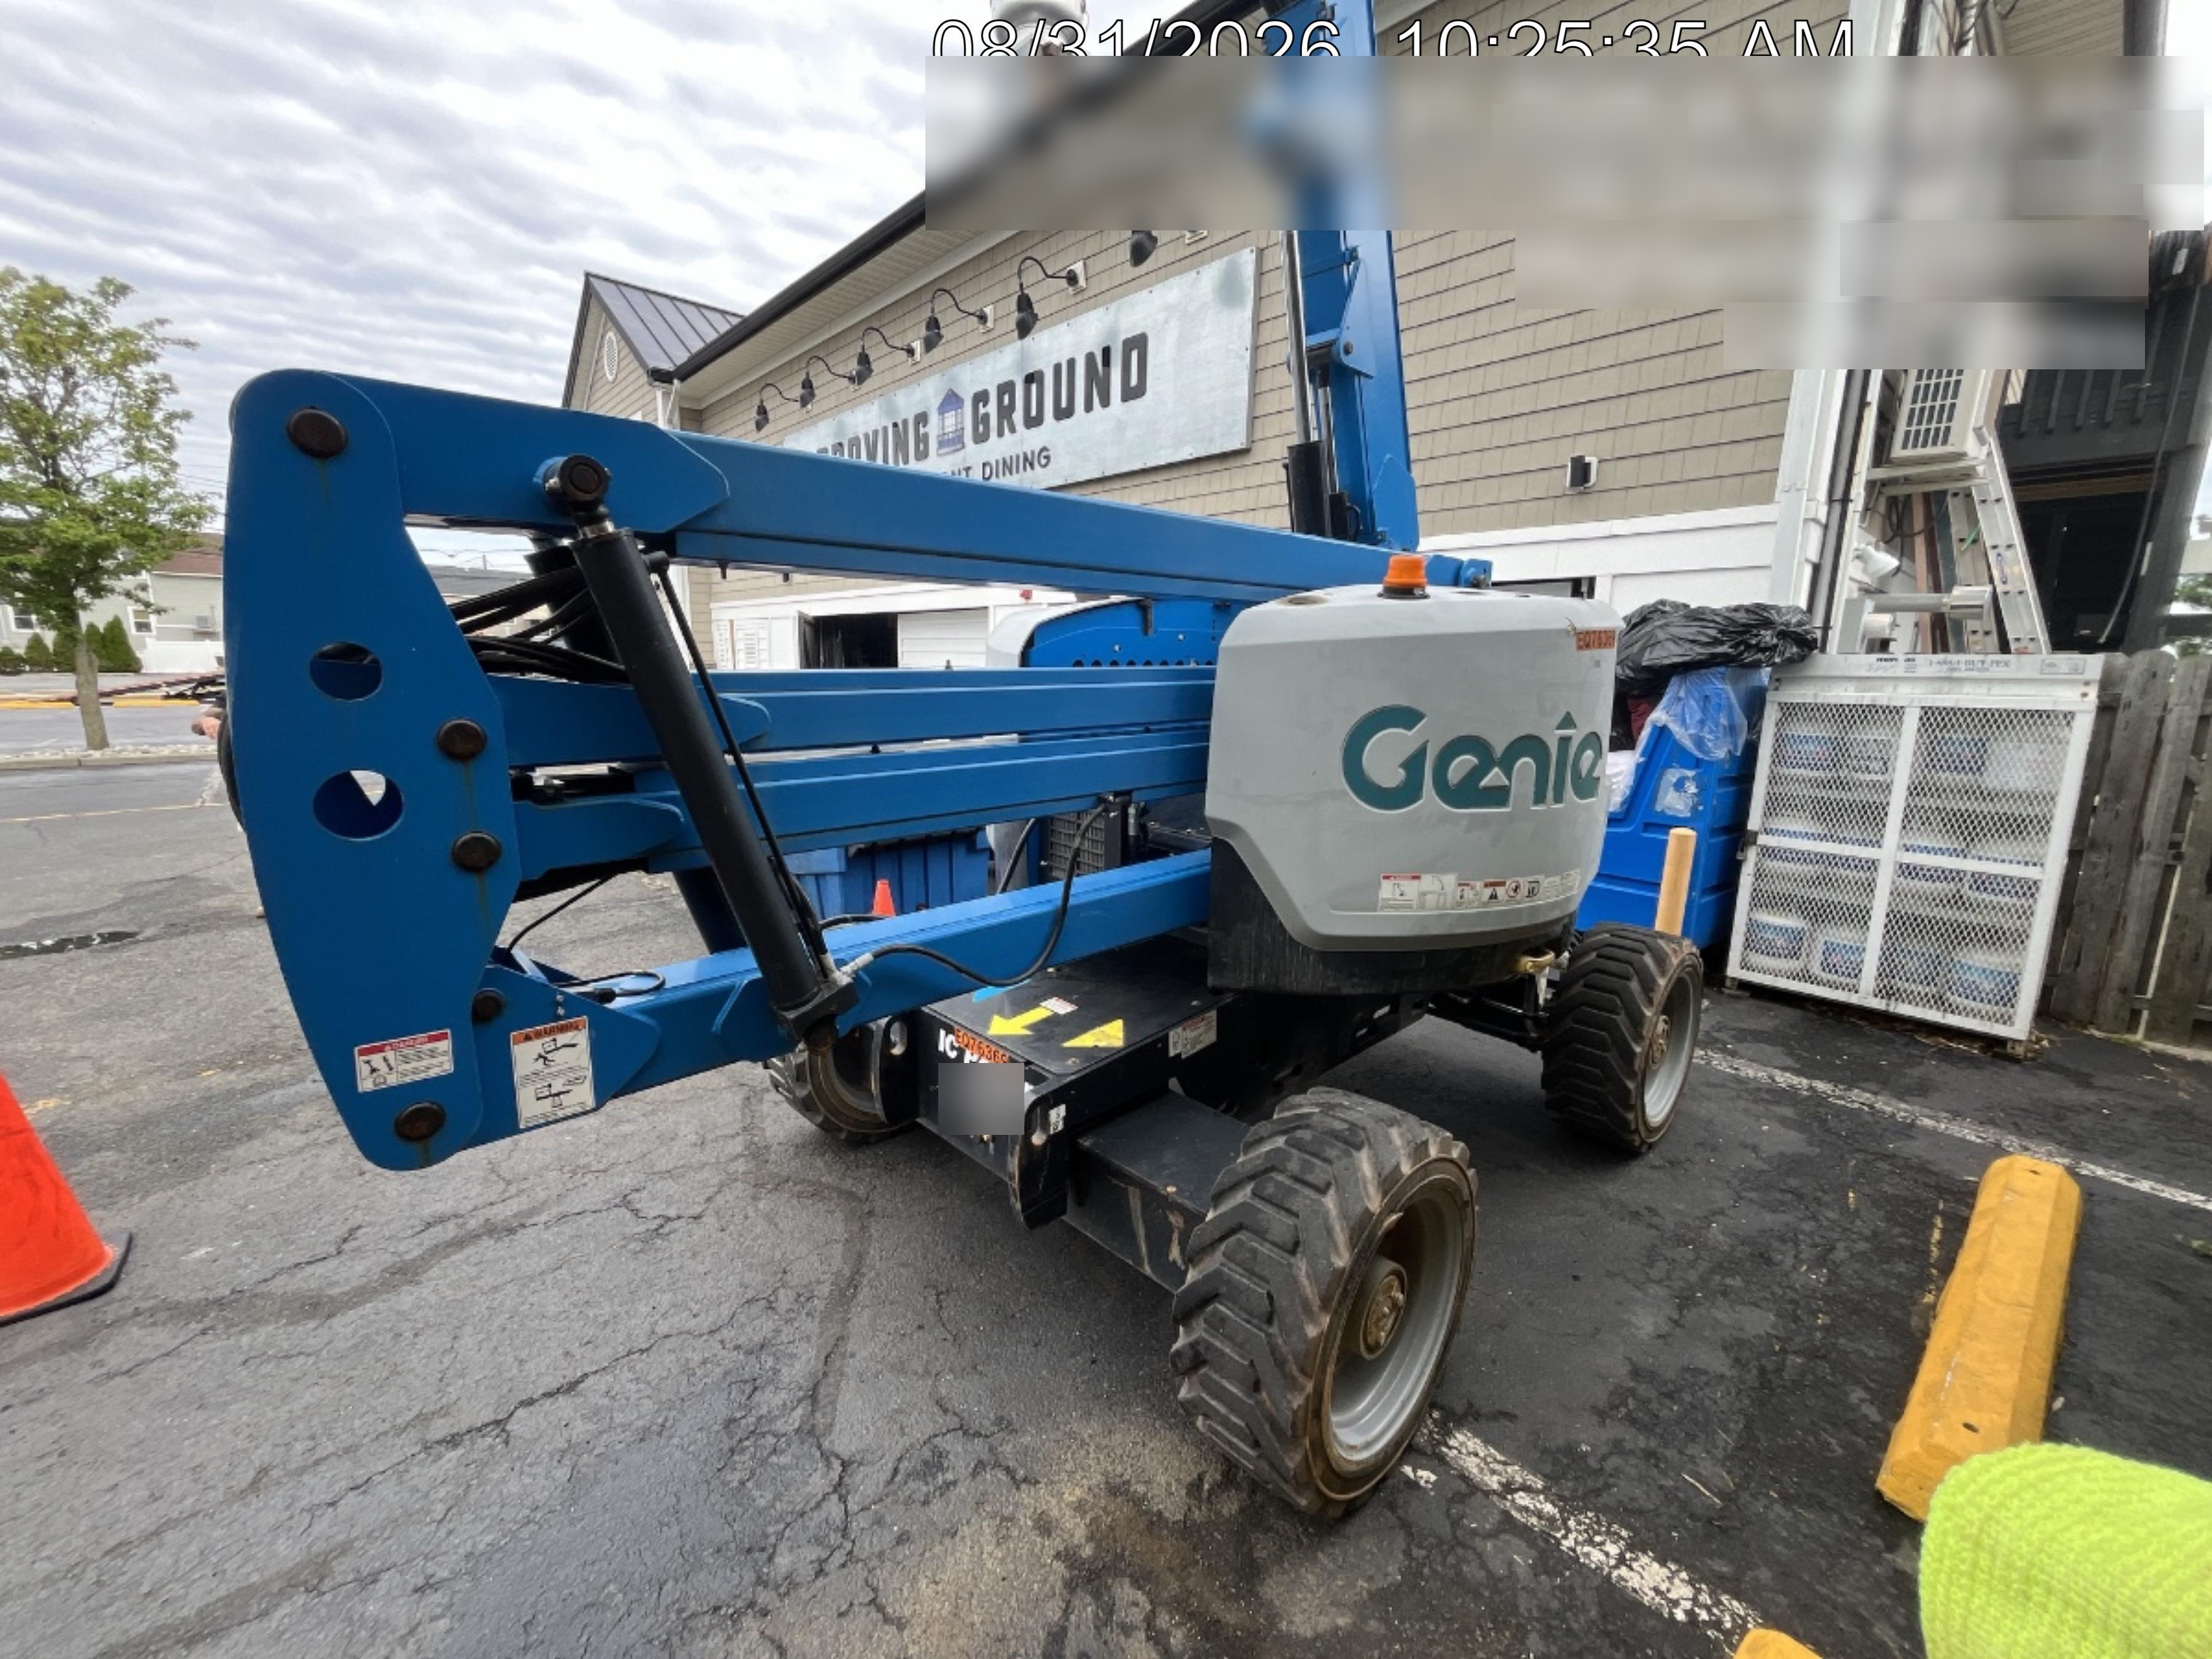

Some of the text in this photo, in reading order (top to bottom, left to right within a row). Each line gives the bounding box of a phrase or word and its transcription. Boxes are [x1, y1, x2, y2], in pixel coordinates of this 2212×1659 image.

[817, 331, 1148, 466] OVING GROUND
[981, 445, 1052, 482] DINING
[1341, 704, 1602, 814] Genie
